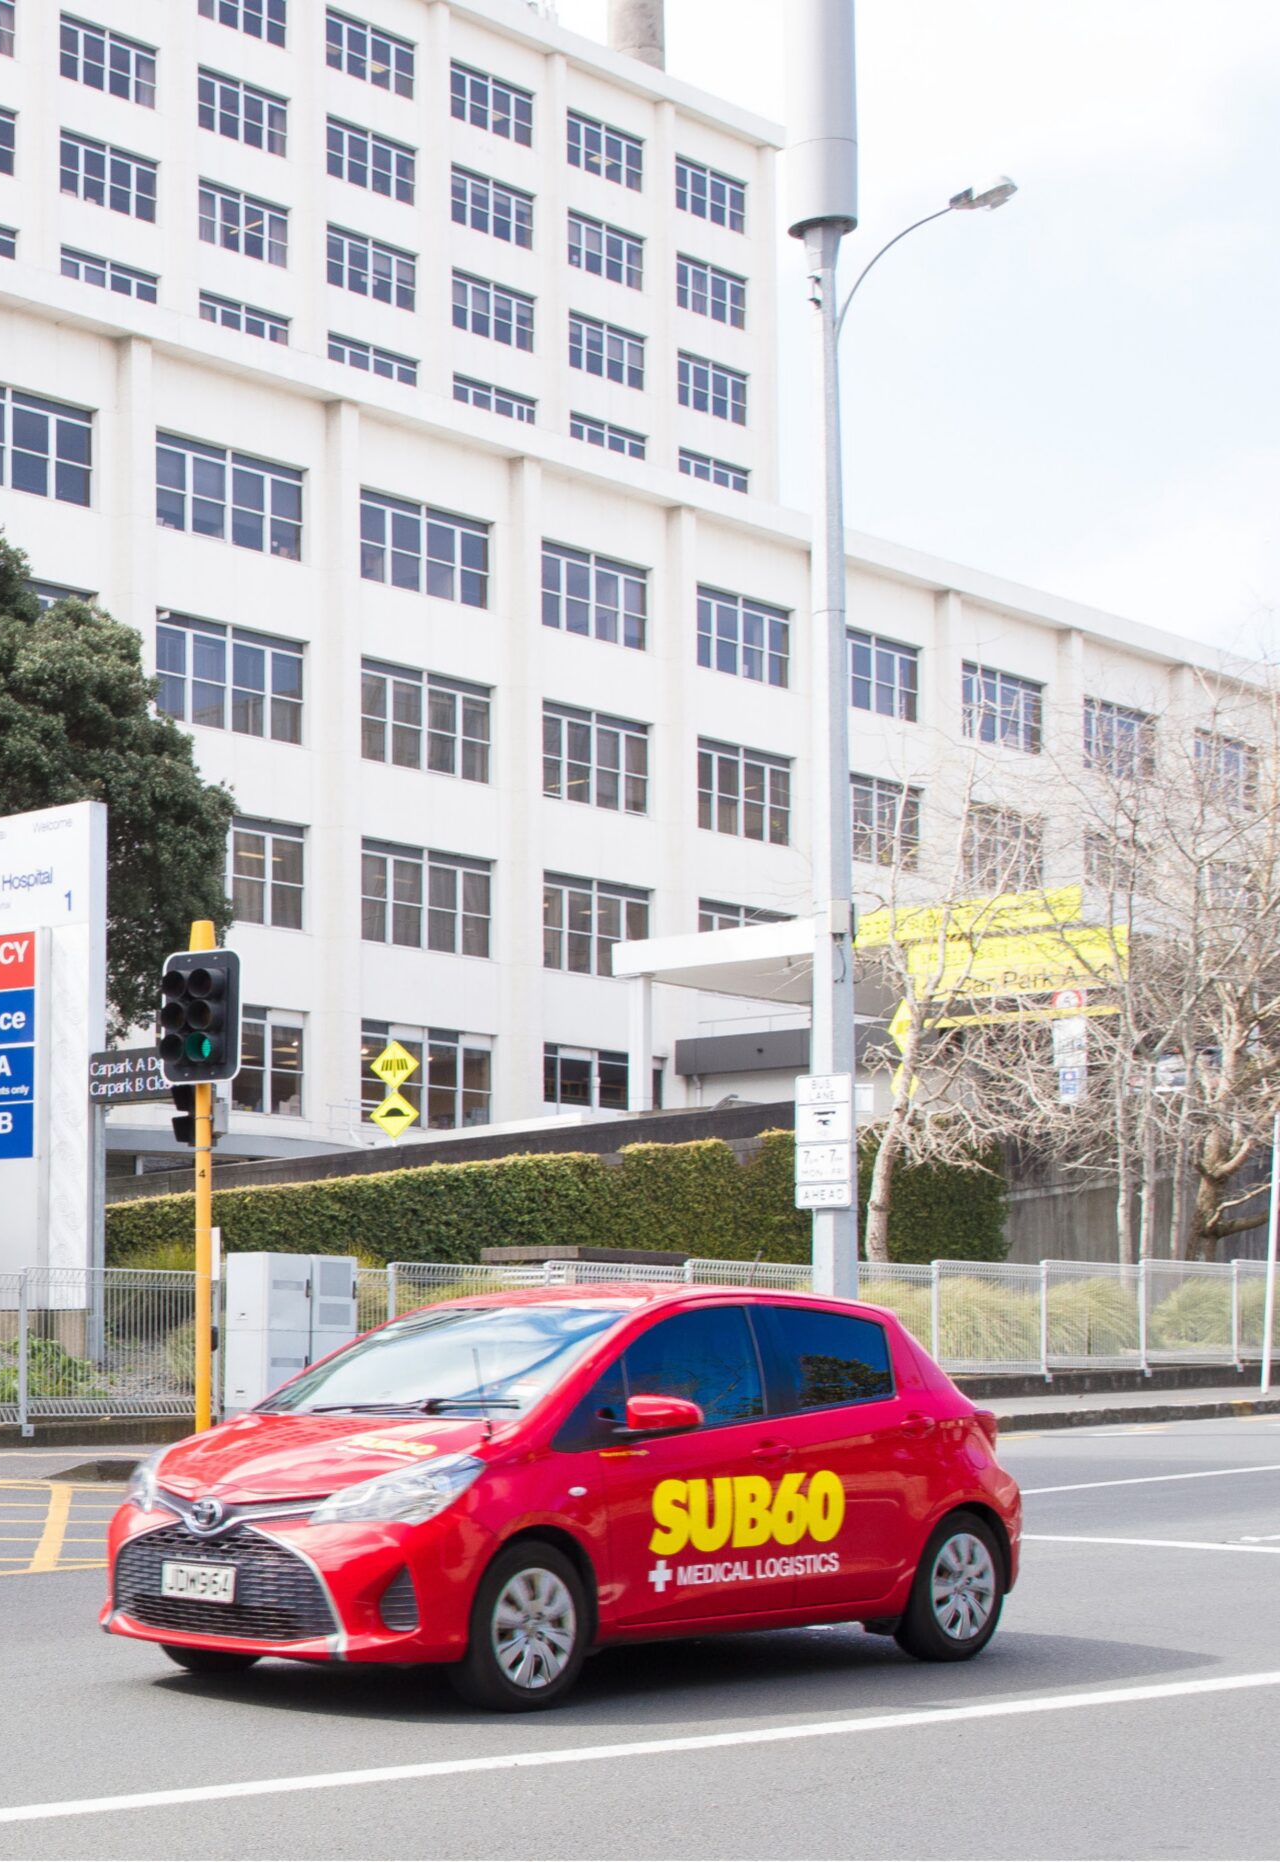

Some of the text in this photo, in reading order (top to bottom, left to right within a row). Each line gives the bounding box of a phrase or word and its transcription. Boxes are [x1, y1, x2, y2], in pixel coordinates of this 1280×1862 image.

[32, 818, 73, 833] Welcome
[1, 866, 53, 892] Hospital
[64, 890, 72, 911] 1
[89, 1058, 133, 1078] Carpark
[135, 1058, 145, 1072] A
[10, 1085, 29, 1096] only
[89, 1078, 133, 1096] Carpark
[135, 1077, 144, 1092] B
[198, 1169, 206, 1178] 4
[648, 1470, 846, 1556] SUB60
[676, 1552, 840, 1586] MEDICAL LOGISTICS
